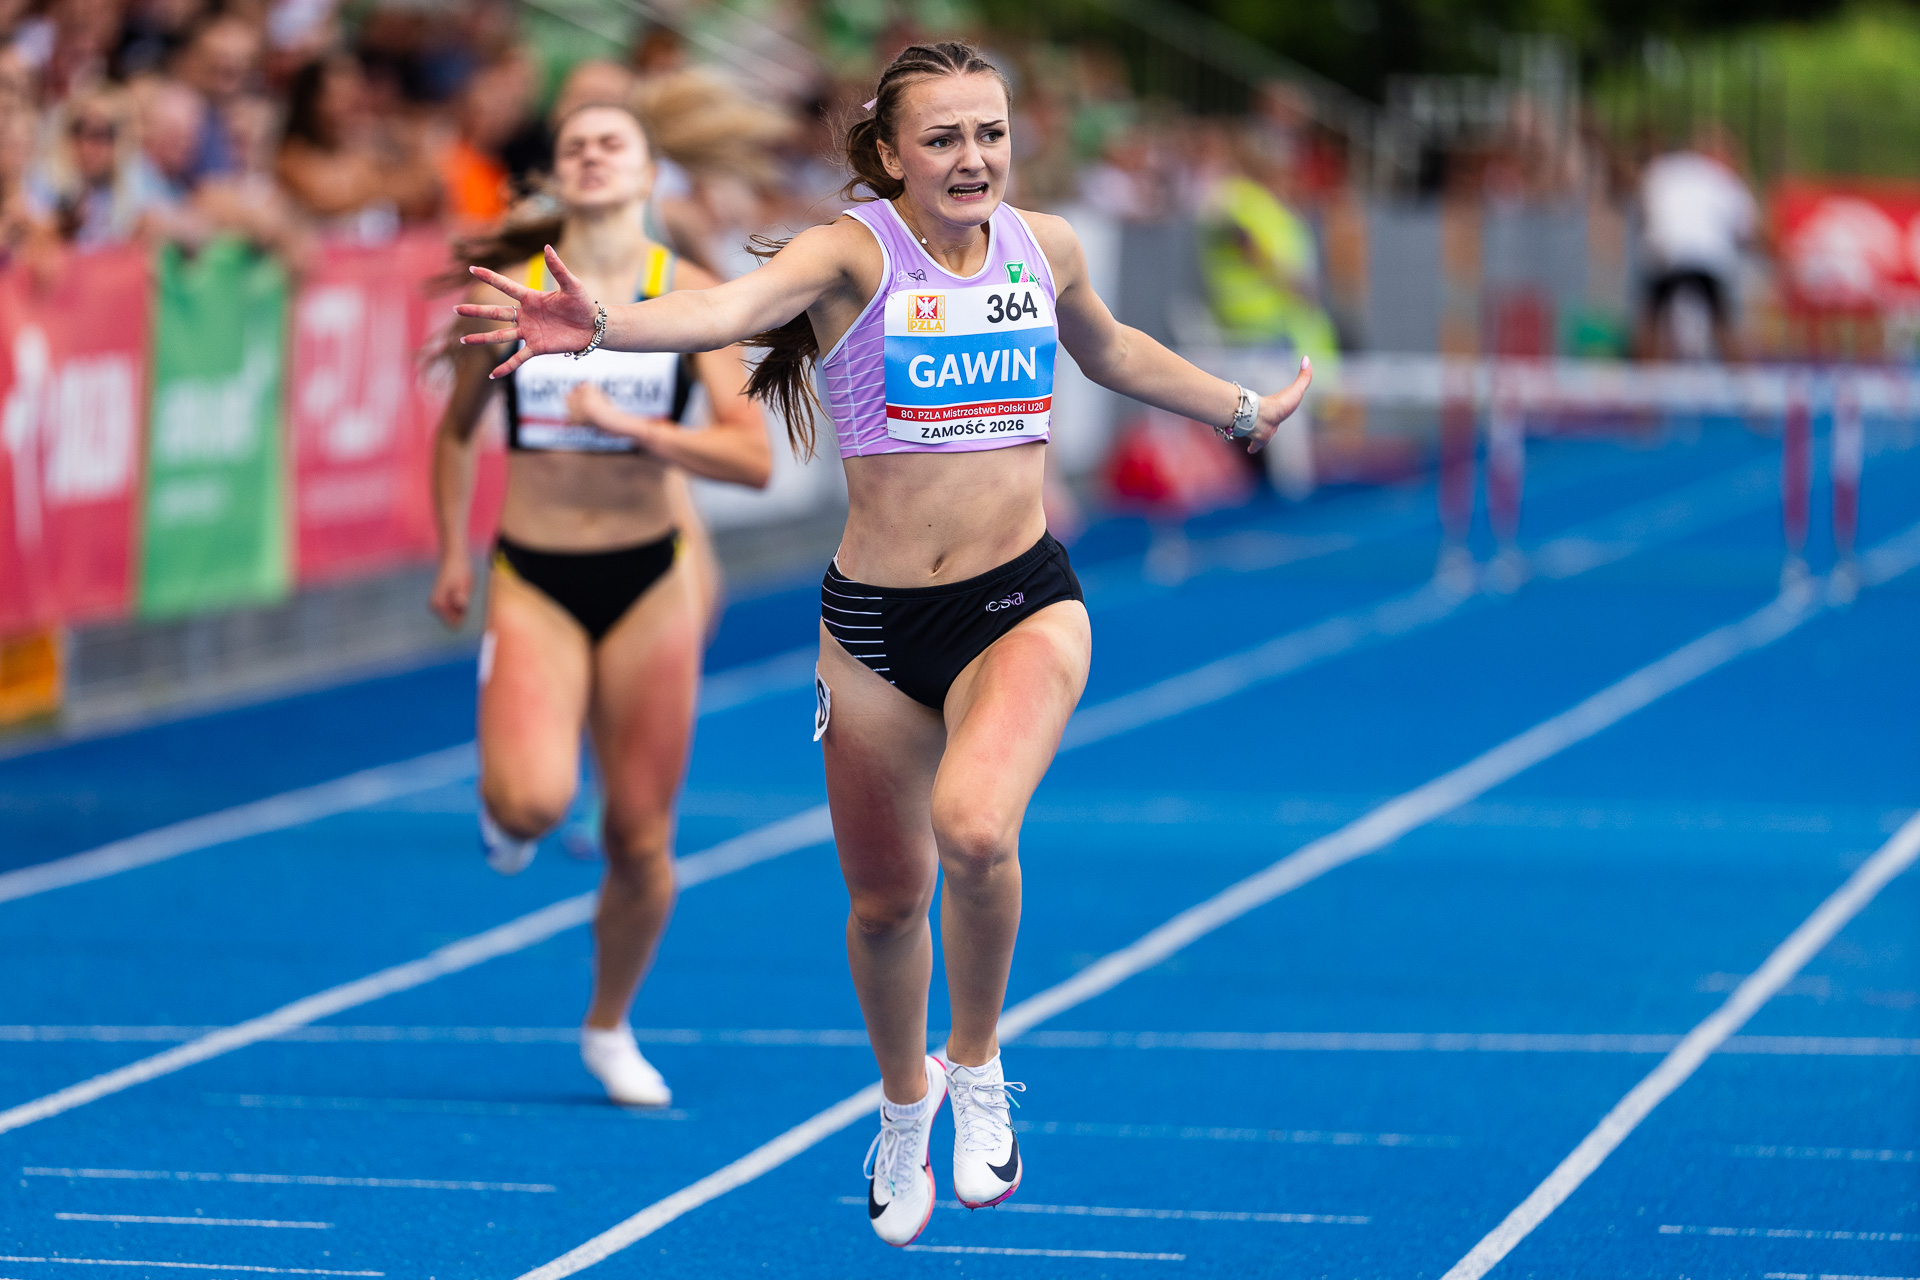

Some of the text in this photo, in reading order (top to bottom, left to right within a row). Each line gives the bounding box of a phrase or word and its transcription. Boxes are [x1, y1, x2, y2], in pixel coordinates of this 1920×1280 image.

[986, 291, 1038, 324] 364
[910, 320, 943, 331] PZLA
[908, 346, 1037, 388] GAWIN
[901, 402, 1044, 420] 80. PZLA Mistrzostwa Polski U20
[921, 419, 1025, 439] ZAMOŚĆ 2026
